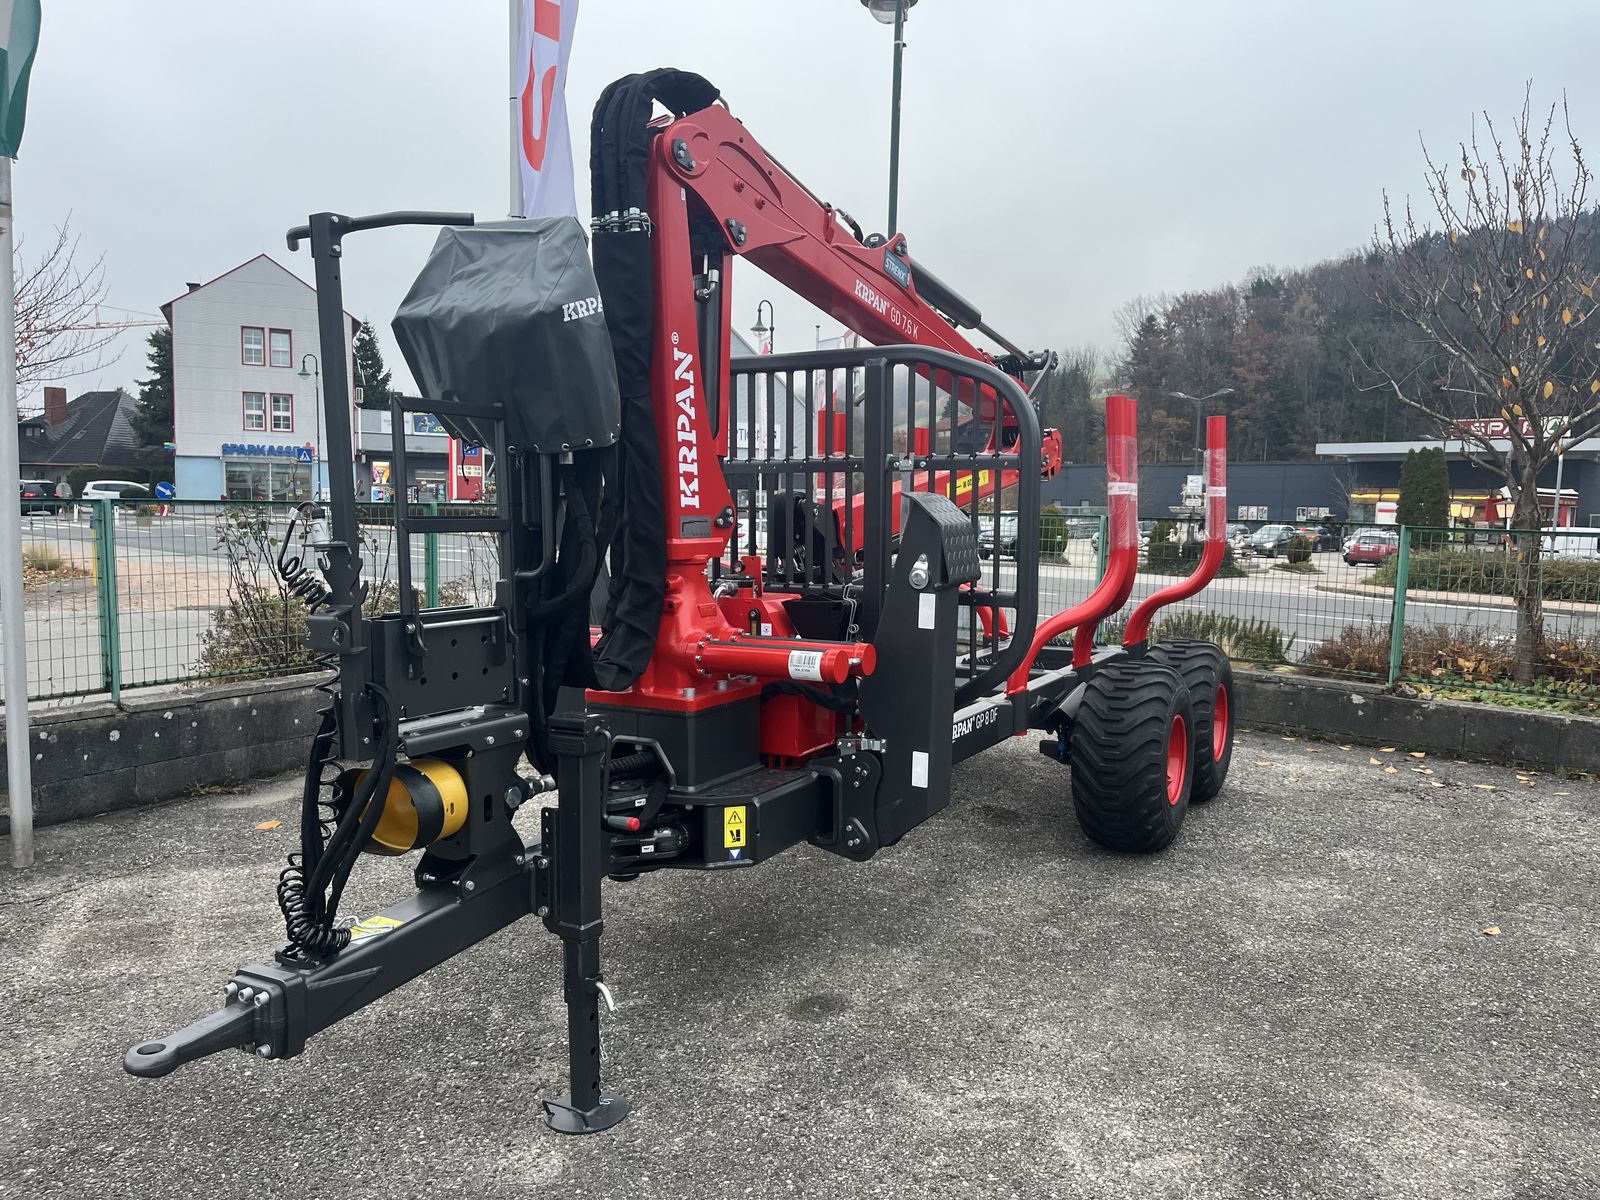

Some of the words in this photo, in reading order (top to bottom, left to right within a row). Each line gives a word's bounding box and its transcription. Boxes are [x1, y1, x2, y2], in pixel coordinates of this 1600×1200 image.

[890, 307, 901, 326] GD
[912, 324, 919, 340] K
[976, 713, 985, 729] GP
[985, 710, 990, 725] 8
